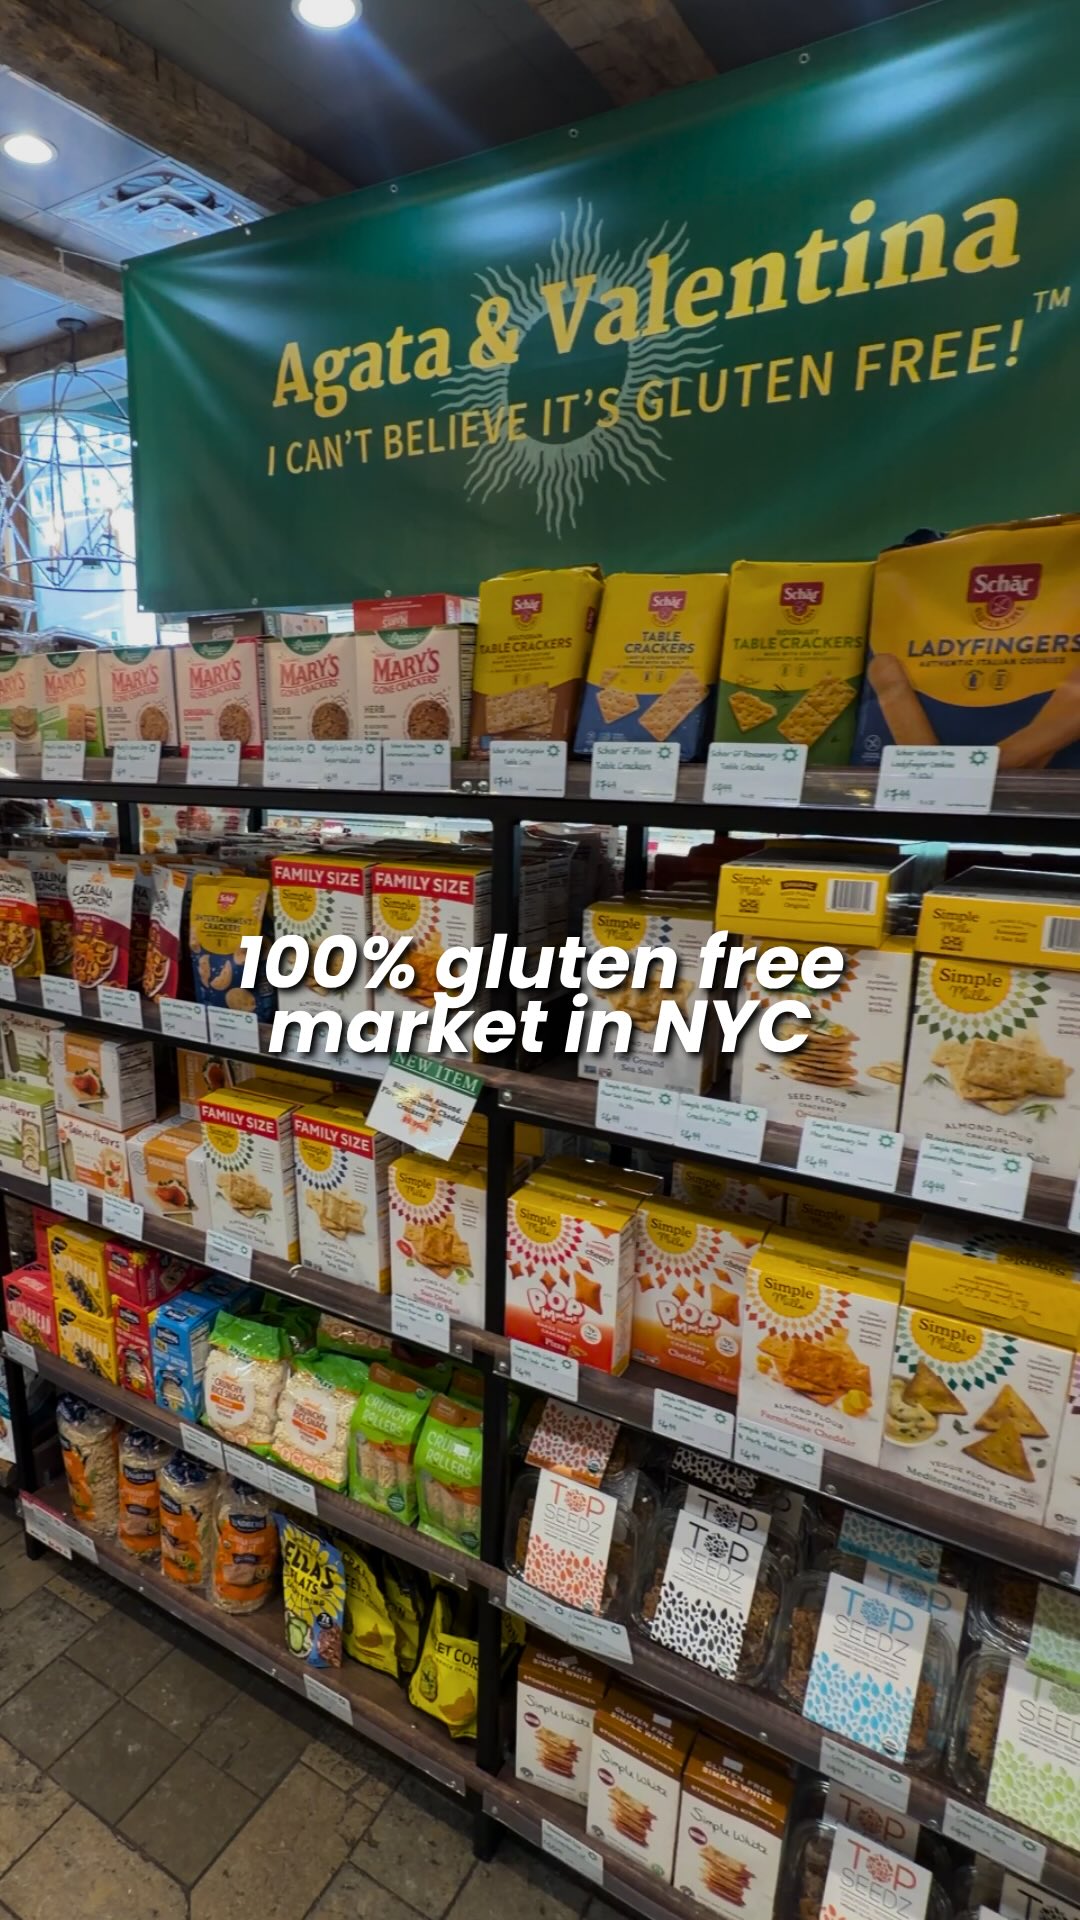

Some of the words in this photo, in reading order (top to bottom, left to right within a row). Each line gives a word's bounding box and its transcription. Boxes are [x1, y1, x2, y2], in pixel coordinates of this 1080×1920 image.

[272, 326, 451, 418] Agata
[469, 296, 519, 370] &
[541, 198, 1020, 354] Valentina
[267, 446, 275, 476] I
[286, 429, 373, 475] CAN'T
[384, 403, 528, 460] BELIEVE
[543, 387, 619, 437] IT'S
[636, 351, 834, 422] GLUTEN
[855, 319, 1024, 392] FREE!
[974, 574, 1034, 595] Schär
[480, 644, 511, 655] TABLE
[512, 637, 573, 652] CRACKERS
[624, 643, 695, 654] CRACKERS
[642, 632, 681, 642] TABLE
[733, 638, 777, 650] TABLE
[780, 636, 864, 649] CRACKERS
[111, 664, 159, 693] MARY'S
[189, 660, 242, 690] MARY'S
[280, 653, 340, 688] MARY'S
[373, 648, 440, 684] MARY'S
[274, 866, 322, 884] FAMILY
[327, 871, 360, 888] SIZE
[375, 872, 430, 891] FAMILY
[434, 878, 470, 896] SIZE
[282, 889, 312, 902] Simple
[382, 896, 417, 912] Simple
[598, 915, 641, 931] Simple
[933, 908, 980, 923] Simple
[939, 968, 1003, 989] Simple
[394, 1050, 433, 1073] NEW
[435, 1065, 480, 1093] ITEM
[814, 1096, 847, 1109] FLOUR
[202, 1105, 244, 1126] FAMILY
[245, 1117, 275, 1135] SIZE
[944, 1123, 992, 1133] ALMOND
[996, 1127, 1034, 1145] FLOUR
[294, 1120, 338, 1142] FAMILY
[341, 1132, 370, 1151] SIZE
[399, 1172, 433, 1190] Simple
[519, 1206, 557, 1228] Simple
[651, 1217, 693, 1239] Simple
[527, 1287, 585, 1318] POP
[763, 1277, 814, 1300] Simple
[656, 1300, 721, 1329] POP
[918, 1317, 976, 1344] Simple
[364, 1393, 416, 1426] CRUNCHY
[814, 1428, 856, 1447] Cheddar
[425, 1449, 472, 1480] ROLLERS
[550, 1479, 605, 1518] TOP
[906, 1464, 985, 1501] Mediterranean
[988, 1494, 1017, 1510] Herb
[544, 1503, 602, 1539] SEEDZ
[689, 1521, 749, 1565] TOP
[290, 1567, 319, 1595] FLATS
[680, 1547, 745, 1589] SEEDZ
[841, 1585, 914, 1634] TOP
[832, 1613, 910, 1662] SEEDZ
[532, 1658, 564, 1677] SIMPLE
[565, 1668, 593, 1685] WHITE
[524, 1694, 560, 1718] Simple
[611, 1711, 647, 1735] SIMPLE
[645, 1730, 673, 1750] WHITE
[614, 1705, 650, 1727] GLUTEN
[651, 1725, 675, 1742] FREE
[600, 1748, 635, 1779] Simple
[706, 1760, 745, 1783] GLUTEN
[747, 1780, 773, 1797] FREE
[702, 1766, 740, 1789] SIMPLE
[741, 1786, 773, 1806] WHITE
[690, 1806, 730, 1836] Simple
[848, 1838, 917, 1891] TOP
[841, 1866, 913, 1916] SEEDZ
